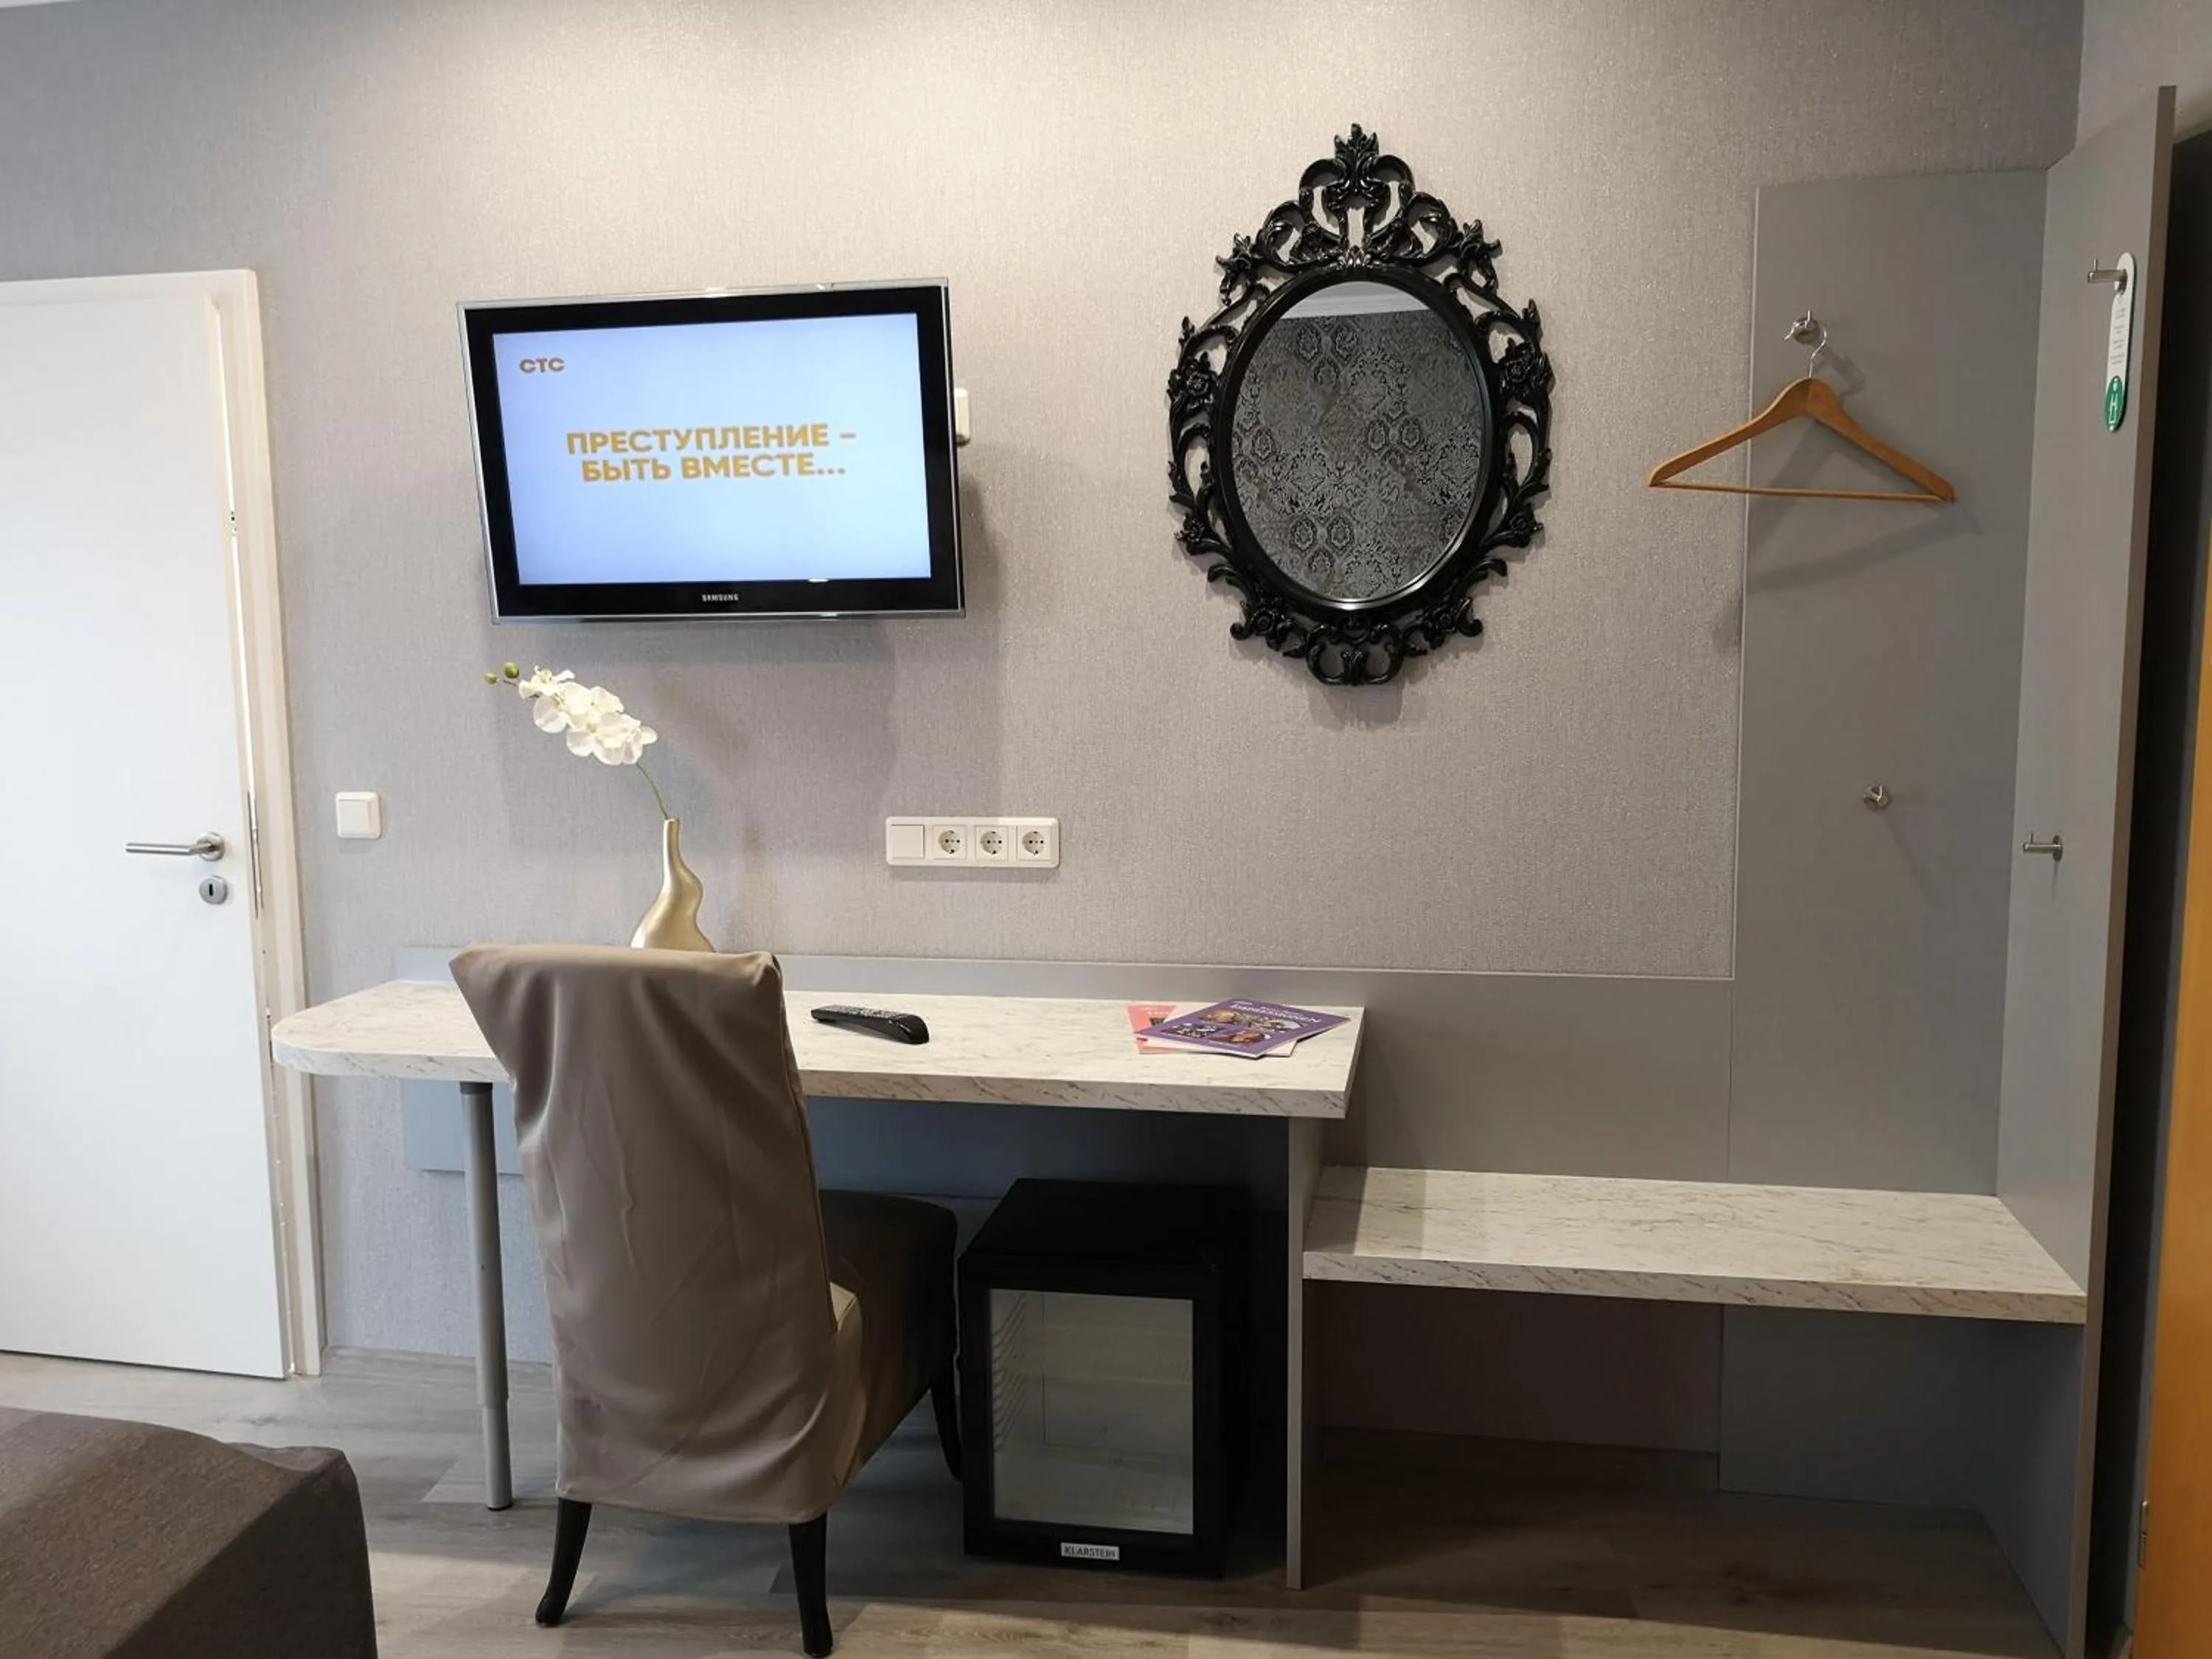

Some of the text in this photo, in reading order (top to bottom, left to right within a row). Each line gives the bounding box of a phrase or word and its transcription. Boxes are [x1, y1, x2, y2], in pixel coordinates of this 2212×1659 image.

[519, 357, 565, 373] СТС
[566, 423, 829, 454] ПРЕСТУПЛЕНИЕ
[581, 452, 846, 482] БЫТЬ ВМЕСТЕ...
[701, 593, 739, 602] SAMSUNG
